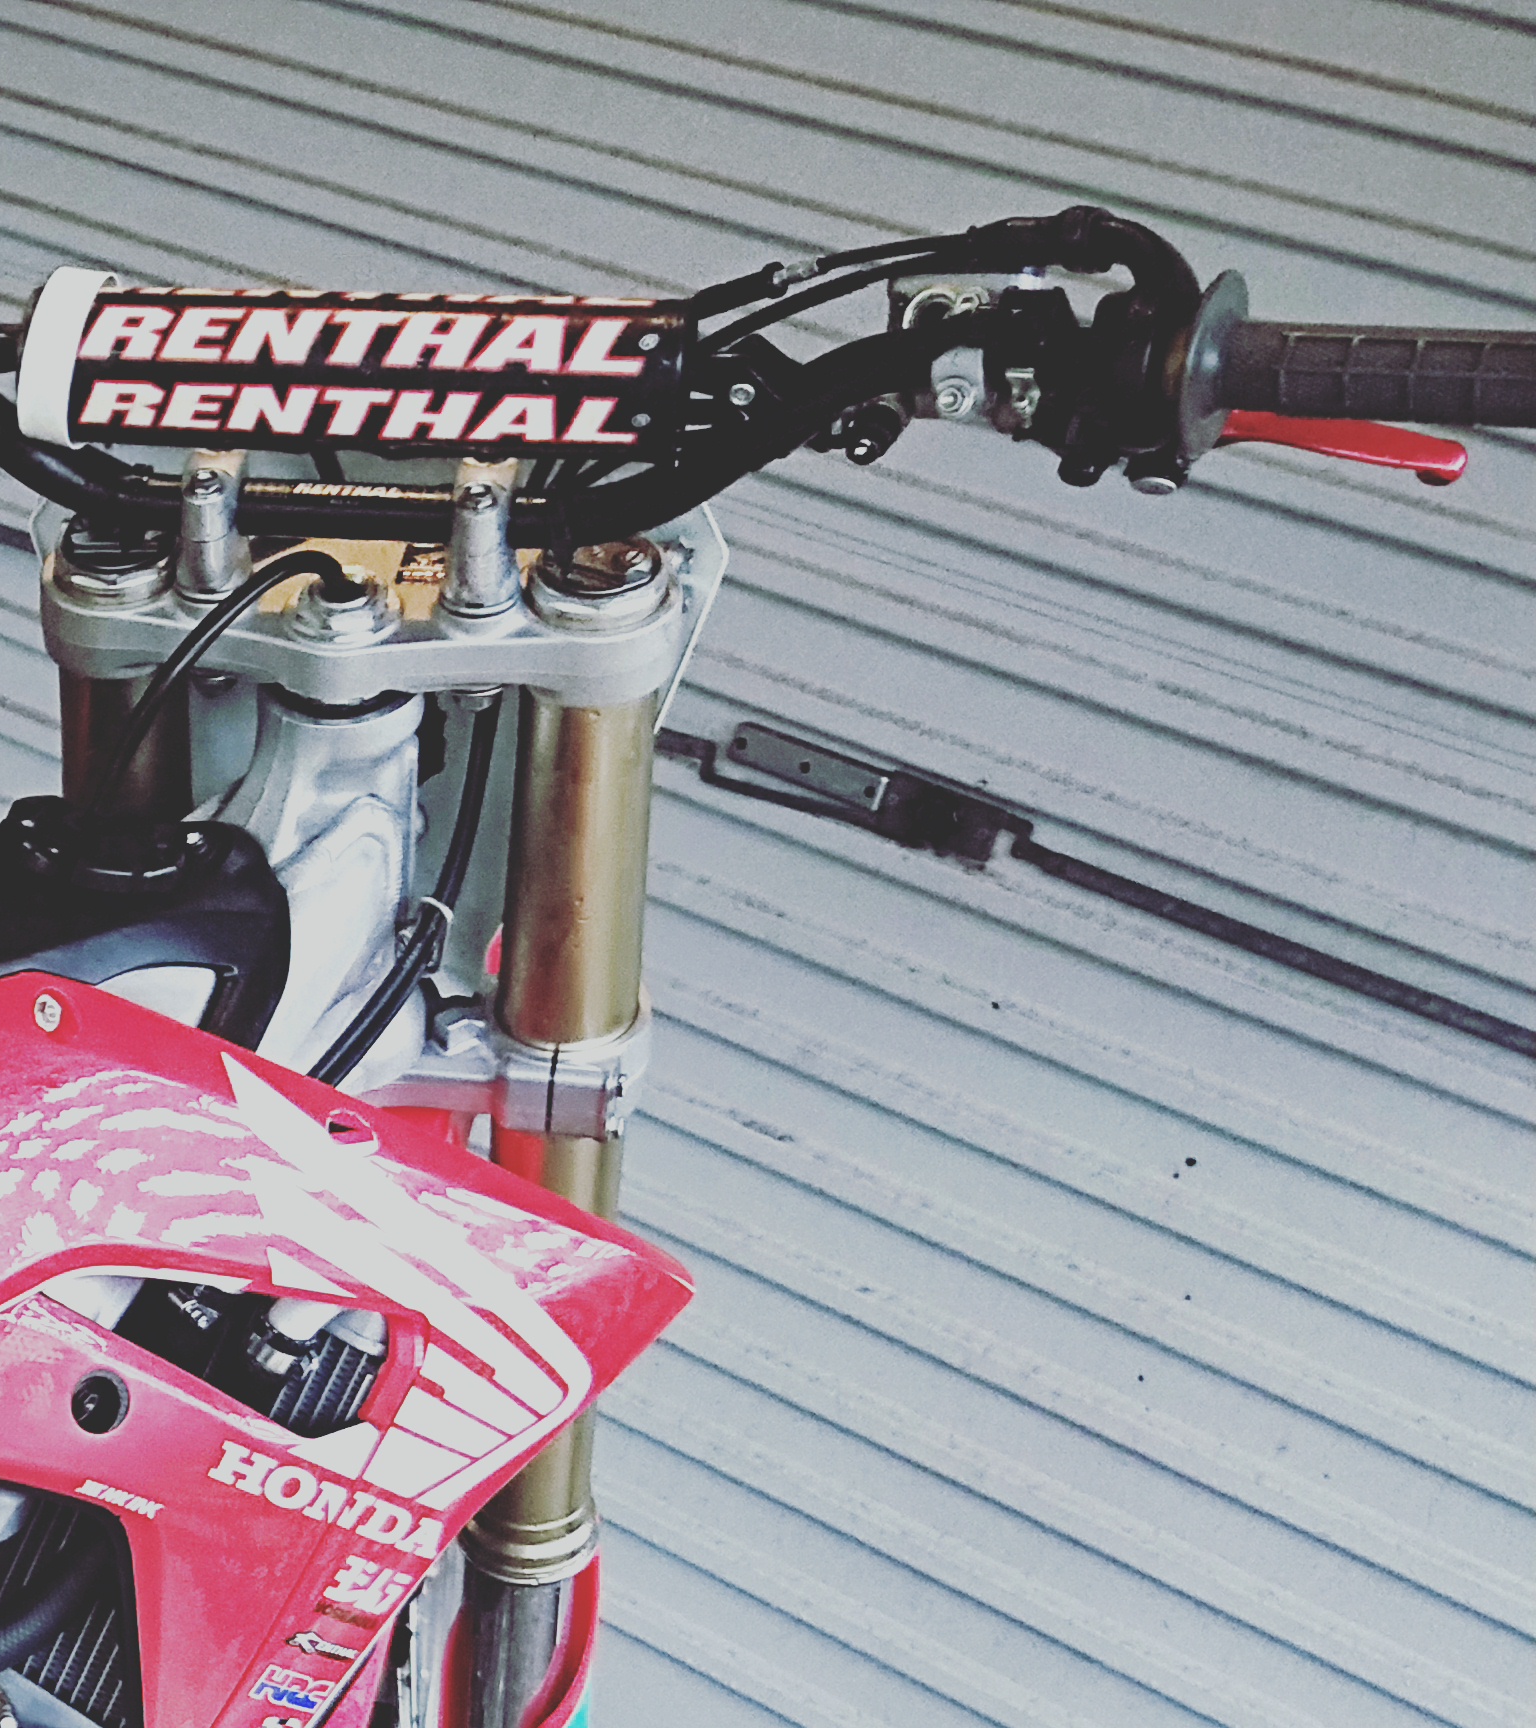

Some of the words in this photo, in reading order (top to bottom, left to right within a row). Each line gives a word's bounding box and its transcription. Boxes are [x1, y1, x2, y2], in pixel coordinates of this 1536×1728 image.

[78, 303, 647, 377] RENTHAL
[78, 379, 638, 444] RENTHAL
[207, 1440, 446, 1559] HONDA
